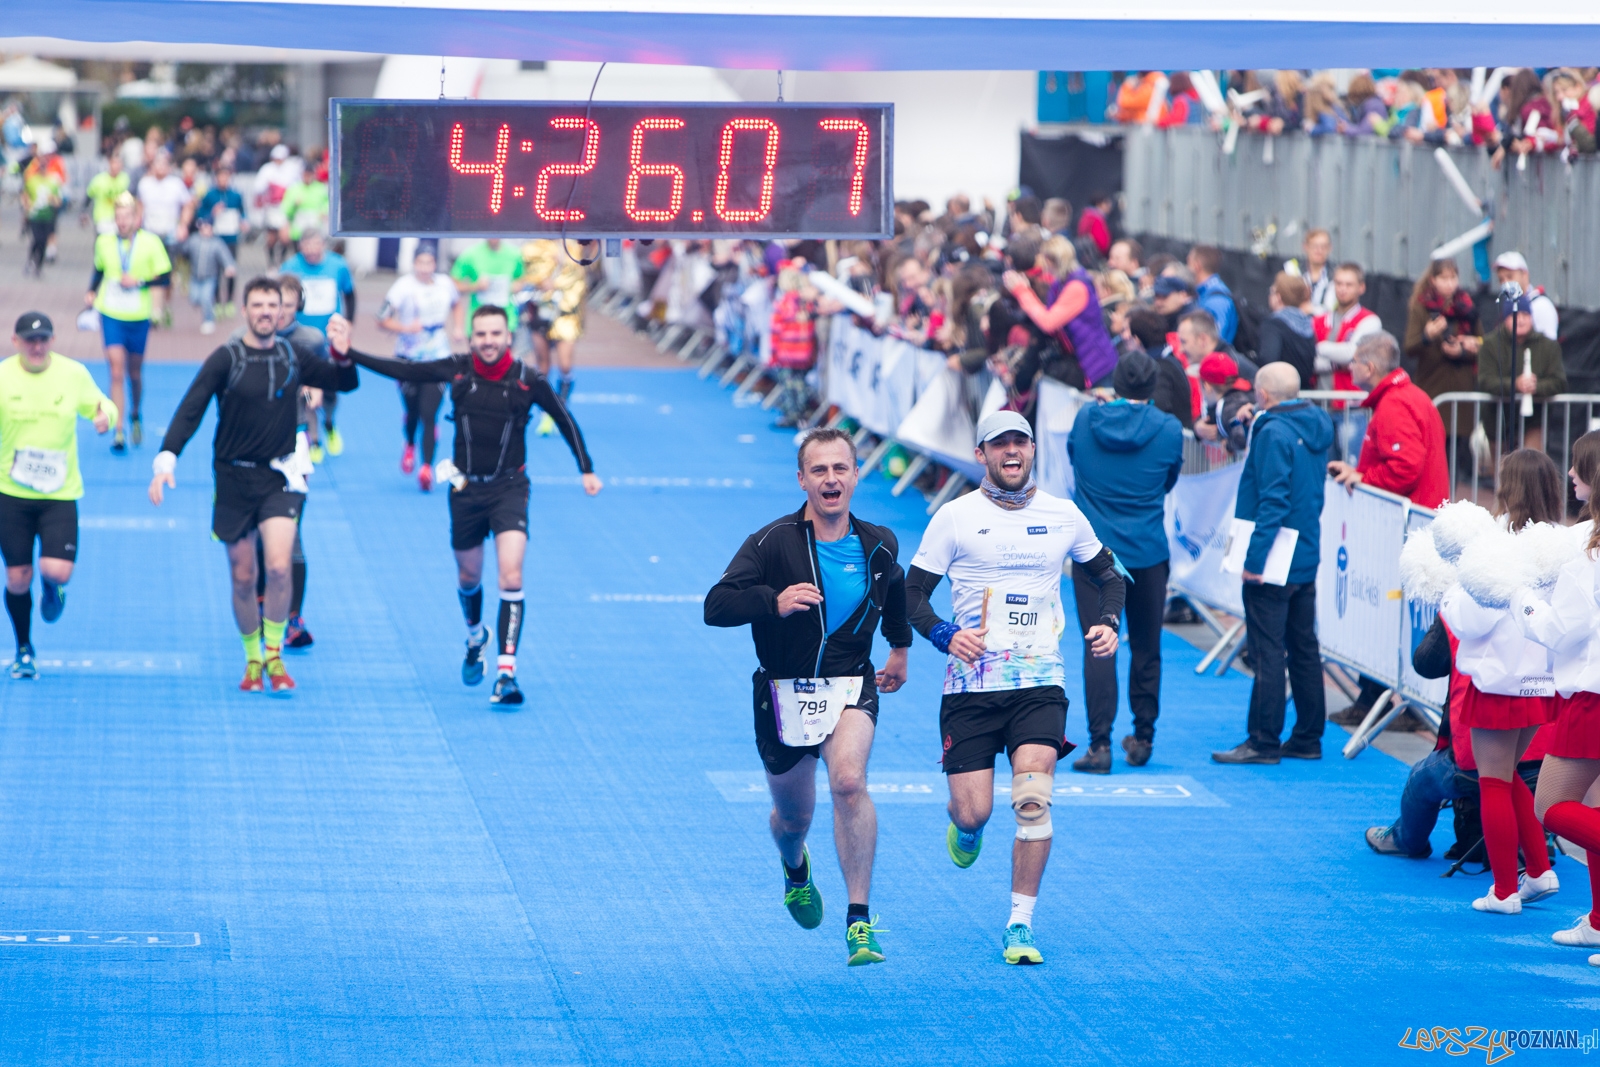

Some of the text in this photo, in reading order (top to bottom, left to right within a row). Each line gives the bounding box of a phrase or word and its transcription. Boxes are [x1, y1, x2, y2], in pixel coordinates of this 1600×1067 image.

[449, 117, 869, 222] 4:26.07
[1002, 551, 1048, 561] ODWAGA
[1008, 611, 1038, 626] 5011
[1519, 687, 1548, 696] razem
[798, 699, 827, 716] 799
